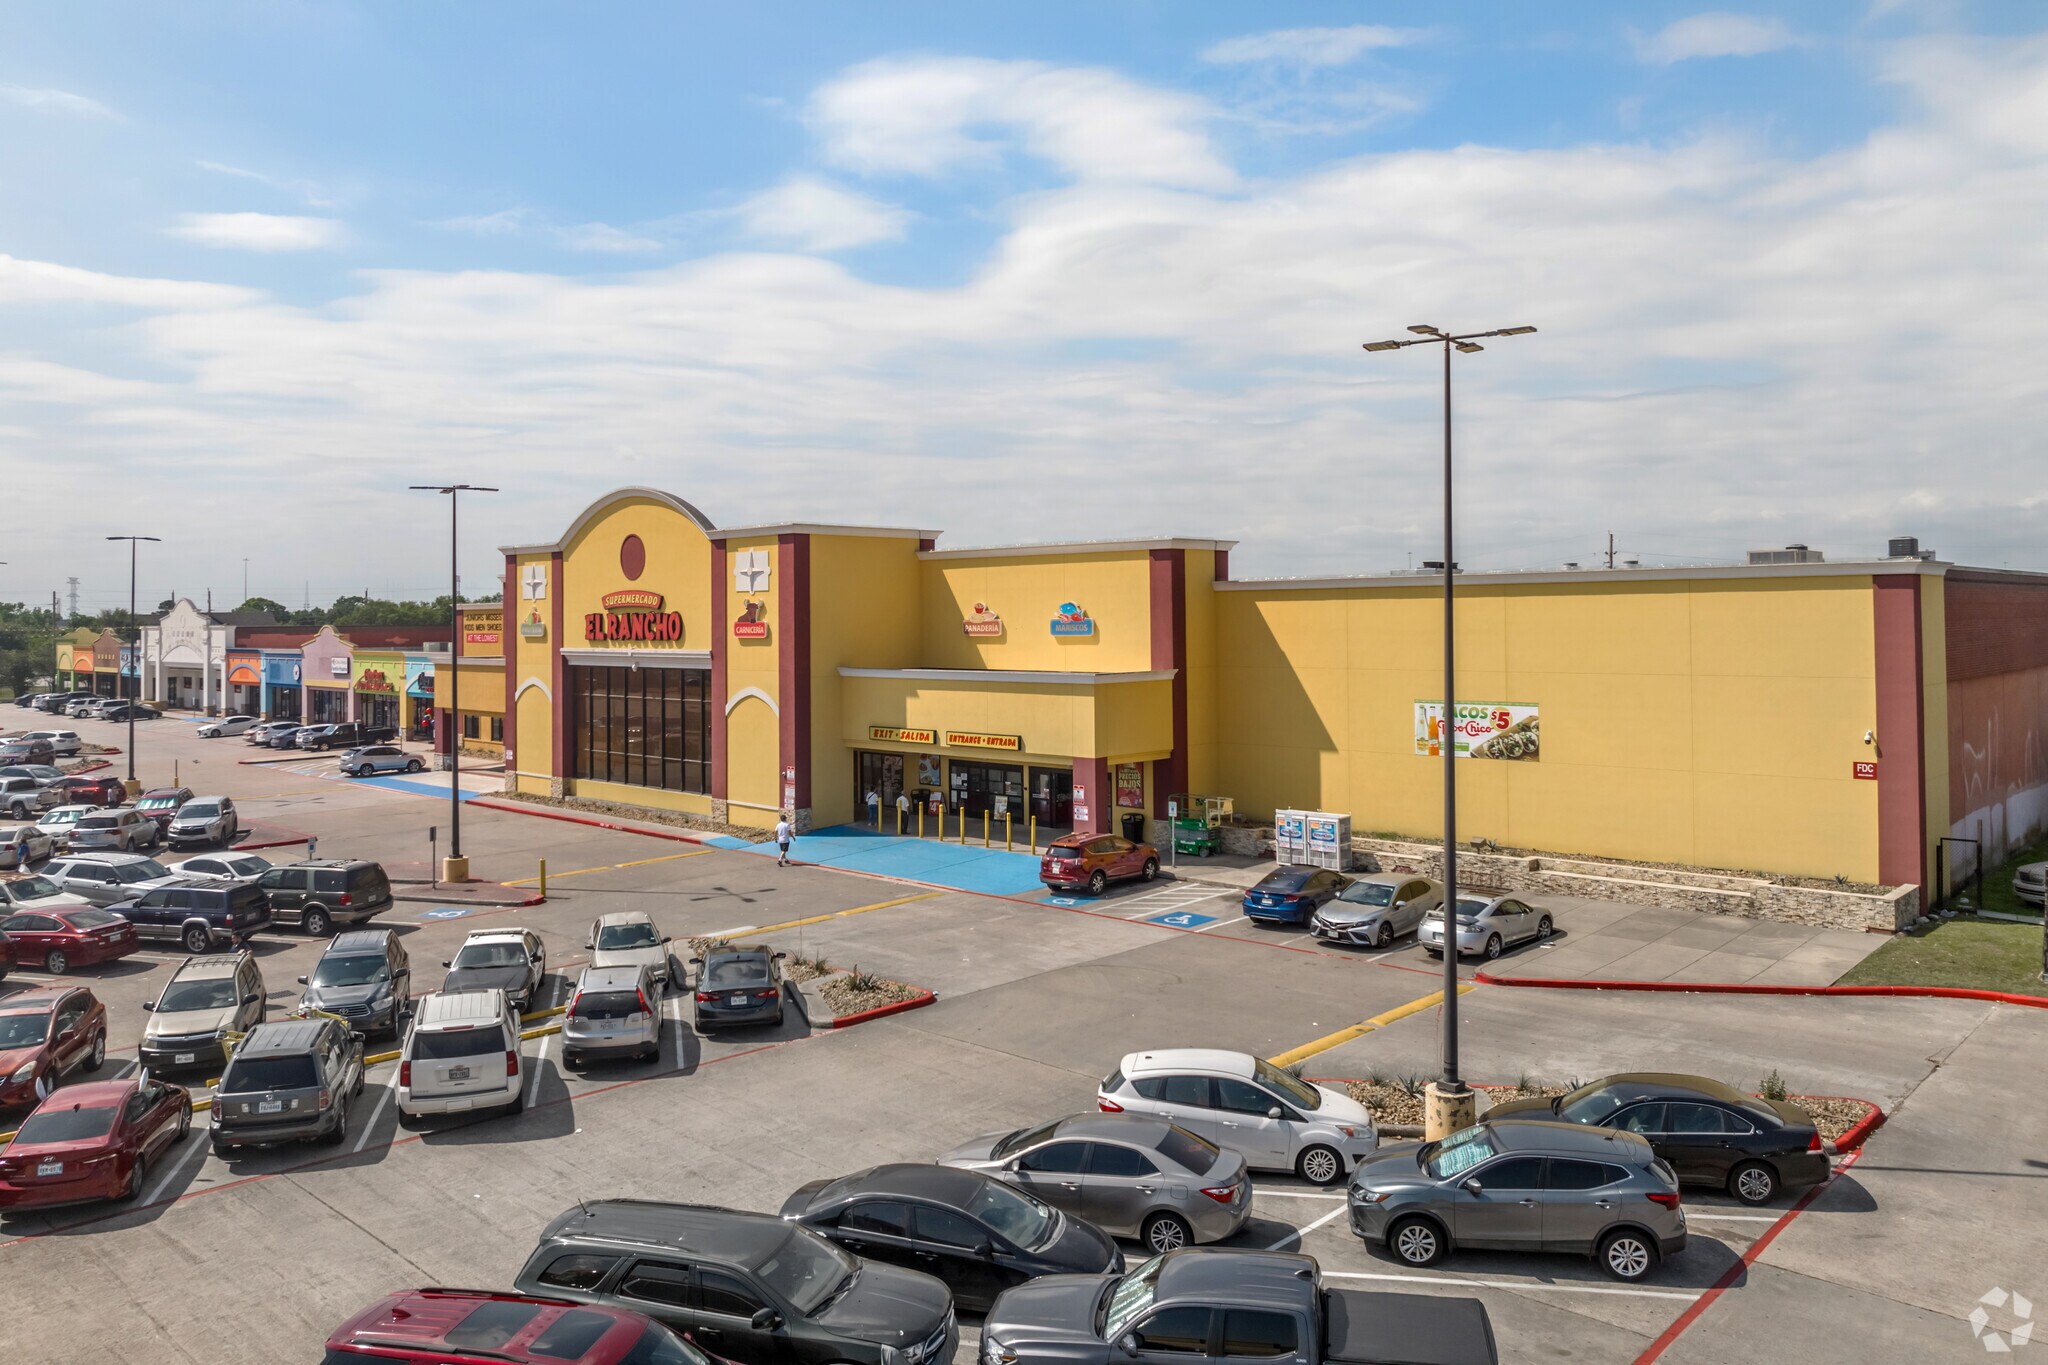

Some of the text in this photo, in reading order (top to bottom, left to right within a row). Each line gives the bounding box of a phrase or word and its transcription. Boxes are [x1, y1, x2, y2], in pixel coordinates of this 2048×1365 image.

[605, 594, 658, 606] SUPERMERCADO
[486, 613, 502, 621] MISSES
[585, 611, 682, 641] EL RANCHO
[736, 625, 764, 633] CARNICERÍA
[965, 623, 998, 632] PANADERÍA
[1056, 624, 1088, 632] MARISCOS
[1491, 711, 1510, 730] $5
[873, 728, 930, 742] EXIT SALIDA
[949, 734, 1016, 747] ENTRANCE ENTRADA
[1857, 763, 1874, 773] FDC
[1119, 780, 1141, 788] BAJOS
